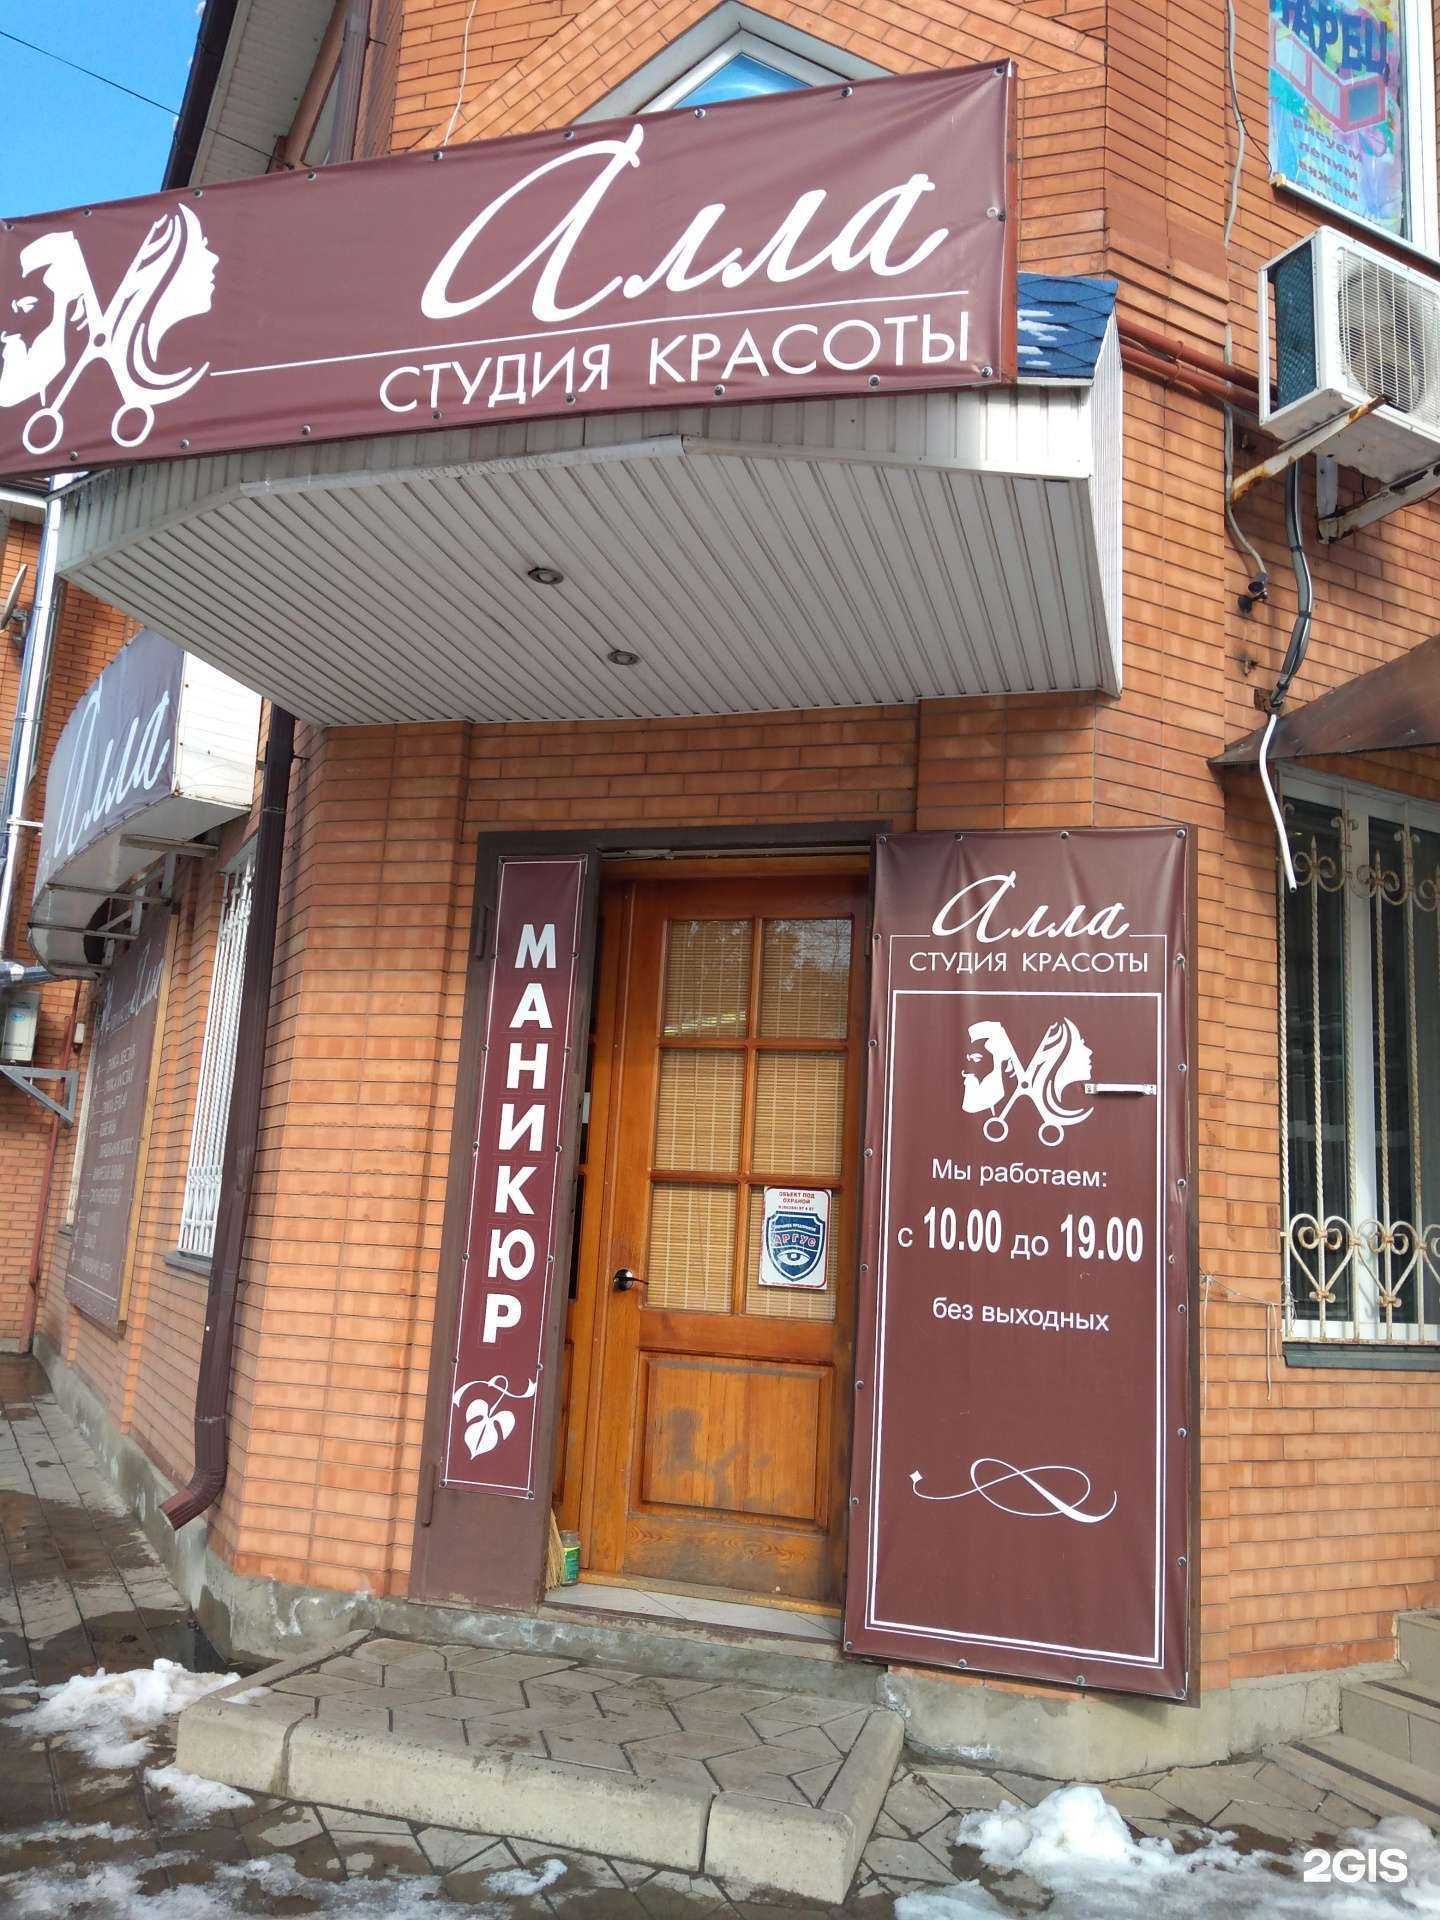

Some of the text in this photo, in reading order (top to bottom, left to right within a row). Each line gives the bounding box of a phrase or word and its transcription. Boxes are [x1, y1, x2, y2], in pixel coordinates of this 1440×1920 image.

[421, 124, 949, 322] Алла
[379, 311, 970, 413] СТУДИЯ КРАСОТЫ
[54, 674, 170, 858] Алла
[931, 870, 1130, 943] Алла
[909, 951, 1148, 974] СТУДИЯ КРАСОТЫ
[482, 923, 557, 1345] МАНИКЮР
[932, 1158, 1108, 1187] Мы работаем:
[923, 1206, 1002, 1254] 10.00
[1010, 1234, 1049, 1261] до
[1060, 1213, 1144, 1263] 19.00
[932, 1296, 1110, 1332] без выходных
